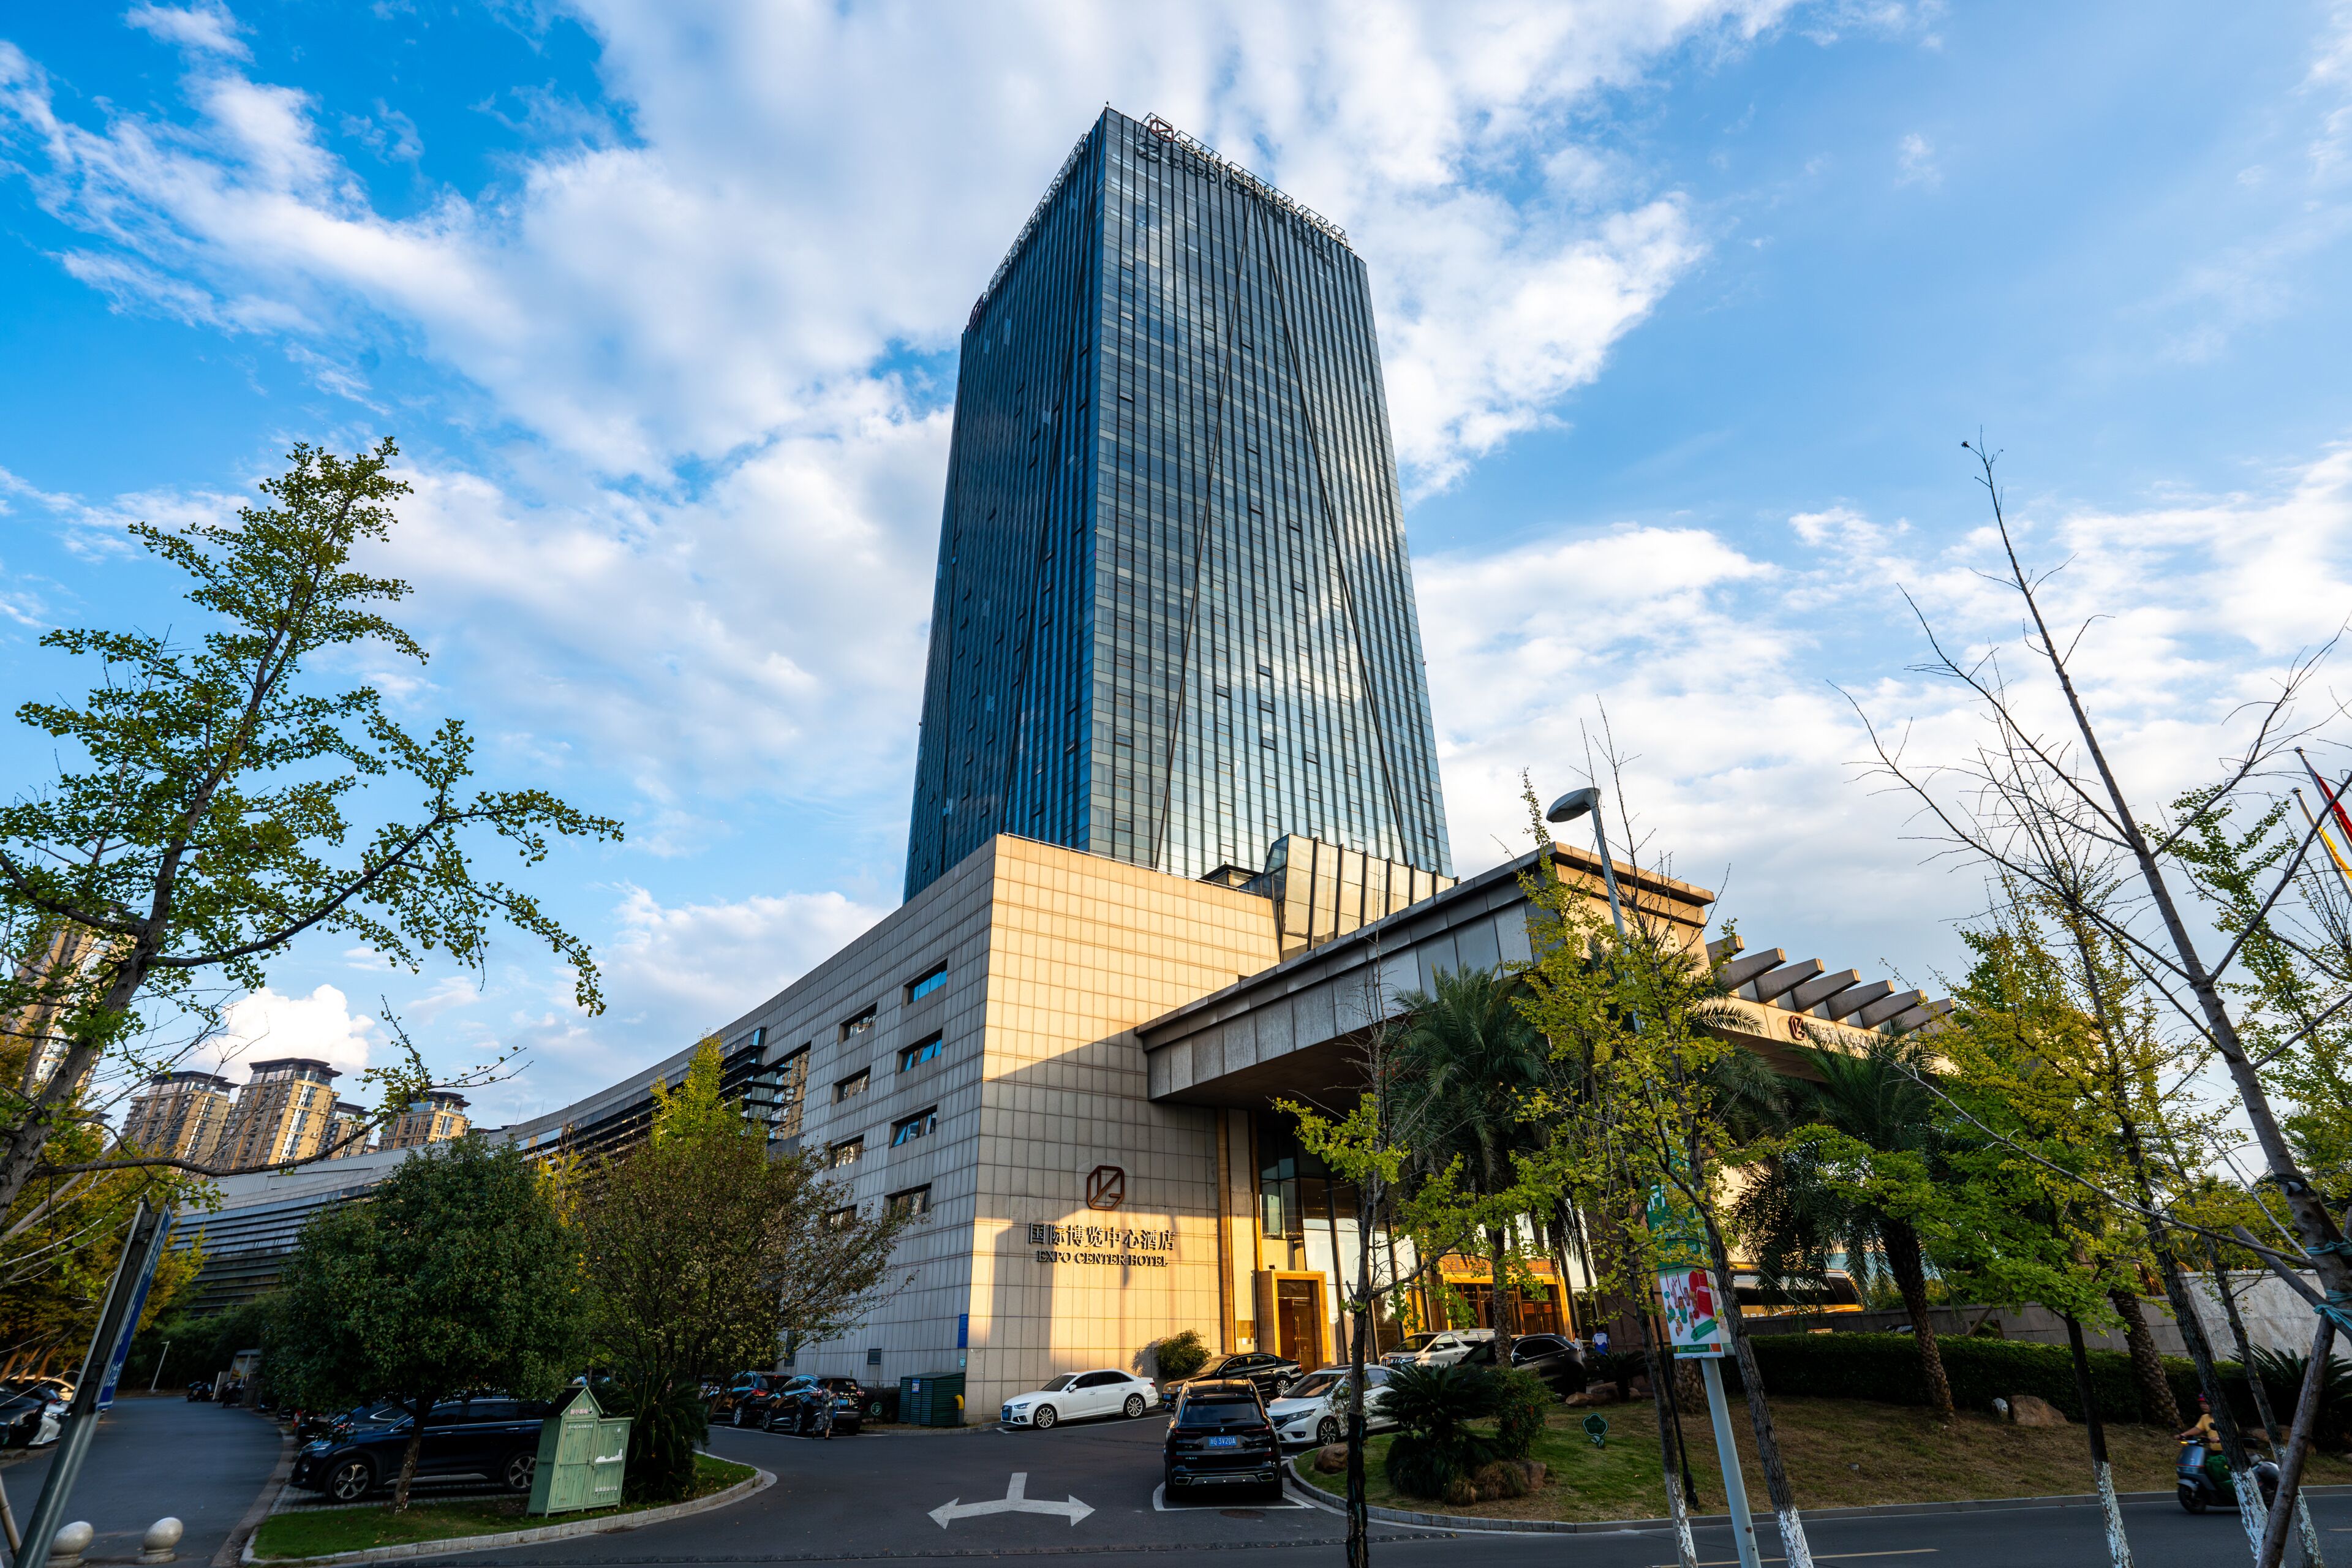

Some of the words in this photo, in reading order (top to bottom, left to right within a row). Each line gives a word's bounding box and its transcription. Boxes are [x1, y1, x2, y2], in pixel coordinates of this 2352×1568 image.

[1178, 137, 1225, 172] EXPO
[1231, 169, 1297, 216] CENTER
[1302, 212, 1353, 251] HOTEL
[1029, 1222, 1175, 1251] 国际博览中心酒店
[1036, 1250, 1071, 1264] EXPO
[1074, 1252, 1126, 1265] CENTER
[1128, 1254, 1169, 1267] HOTEL
